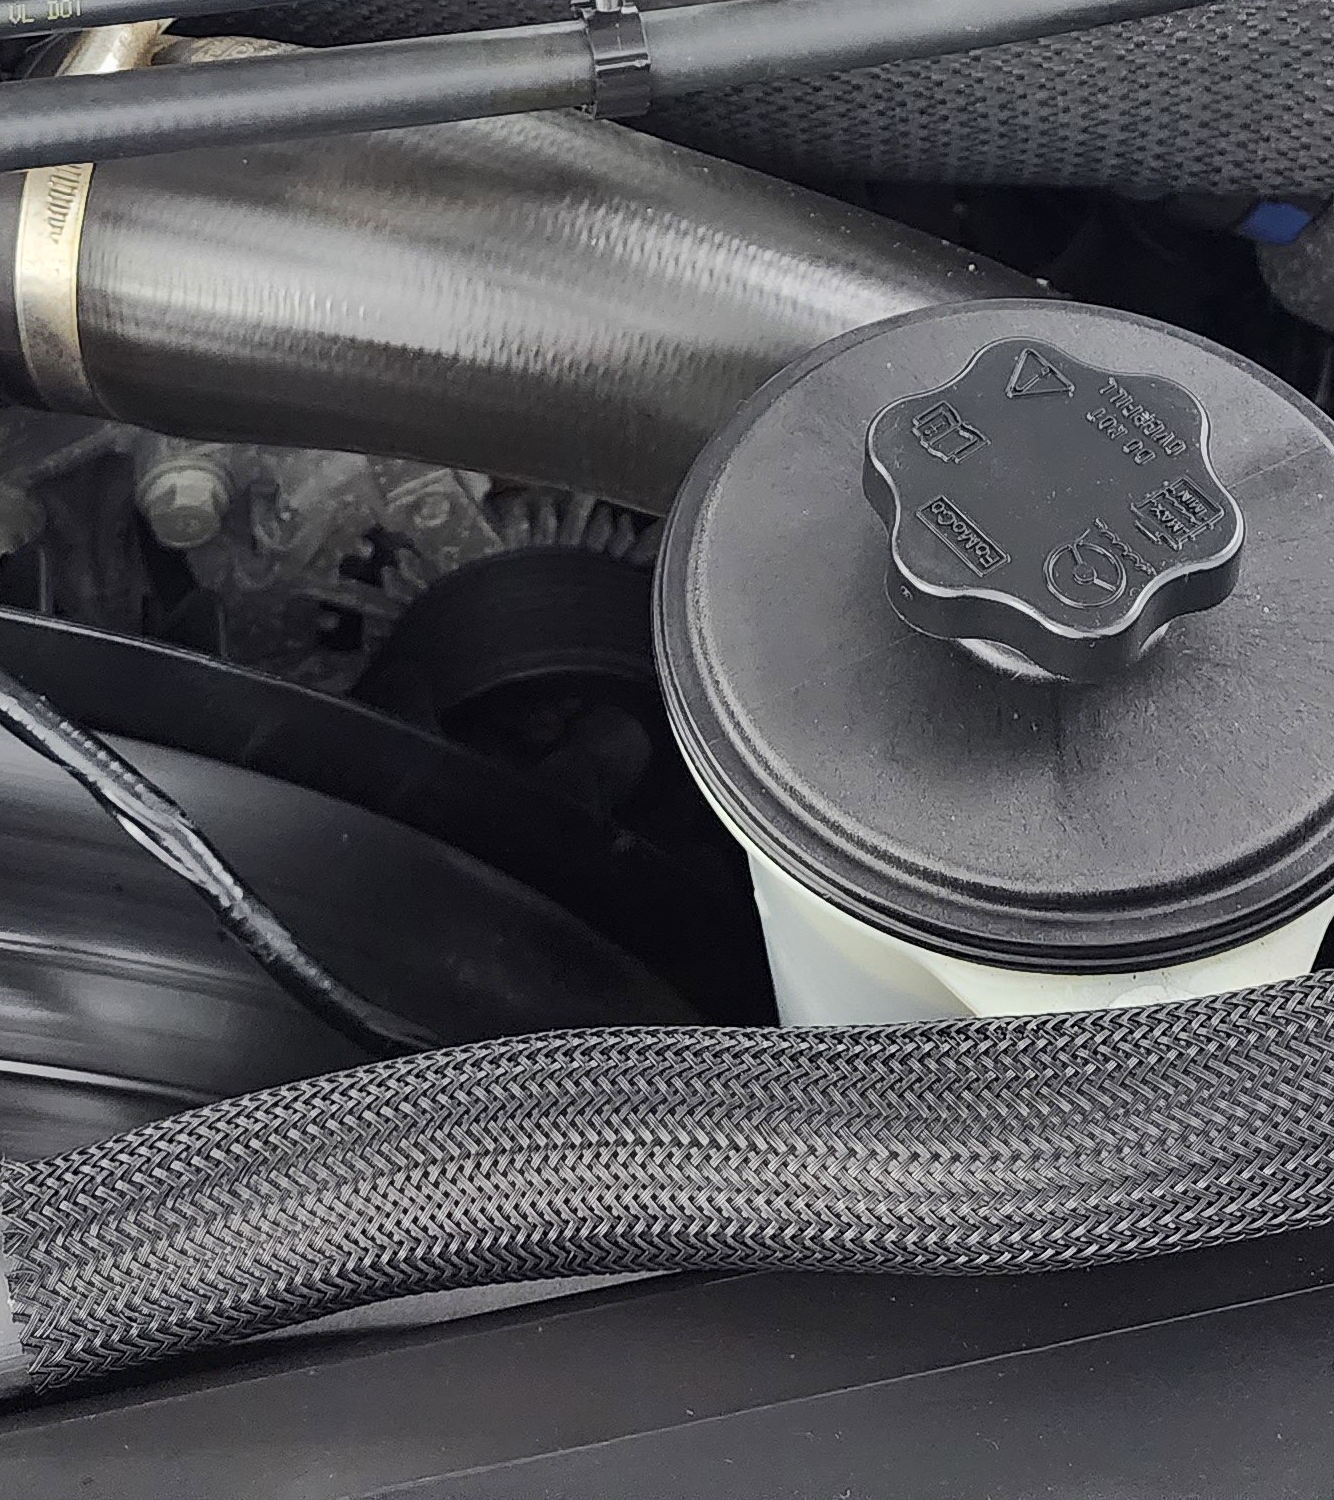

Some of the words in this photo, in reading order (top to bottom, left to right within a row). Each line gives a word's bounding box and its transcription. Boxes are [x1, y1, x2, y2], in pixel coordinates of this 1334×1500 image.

[1085, 407, 1129, 440] NOT
[1099, 377, 1187, 456] OVERFILL
[1122, 438, 1157, 466] DO
[1149, 502, 1192, 535] MAX
[1176, 488, 1208, 517] MIN
[930, 500, 996, 569] FoMoCo
